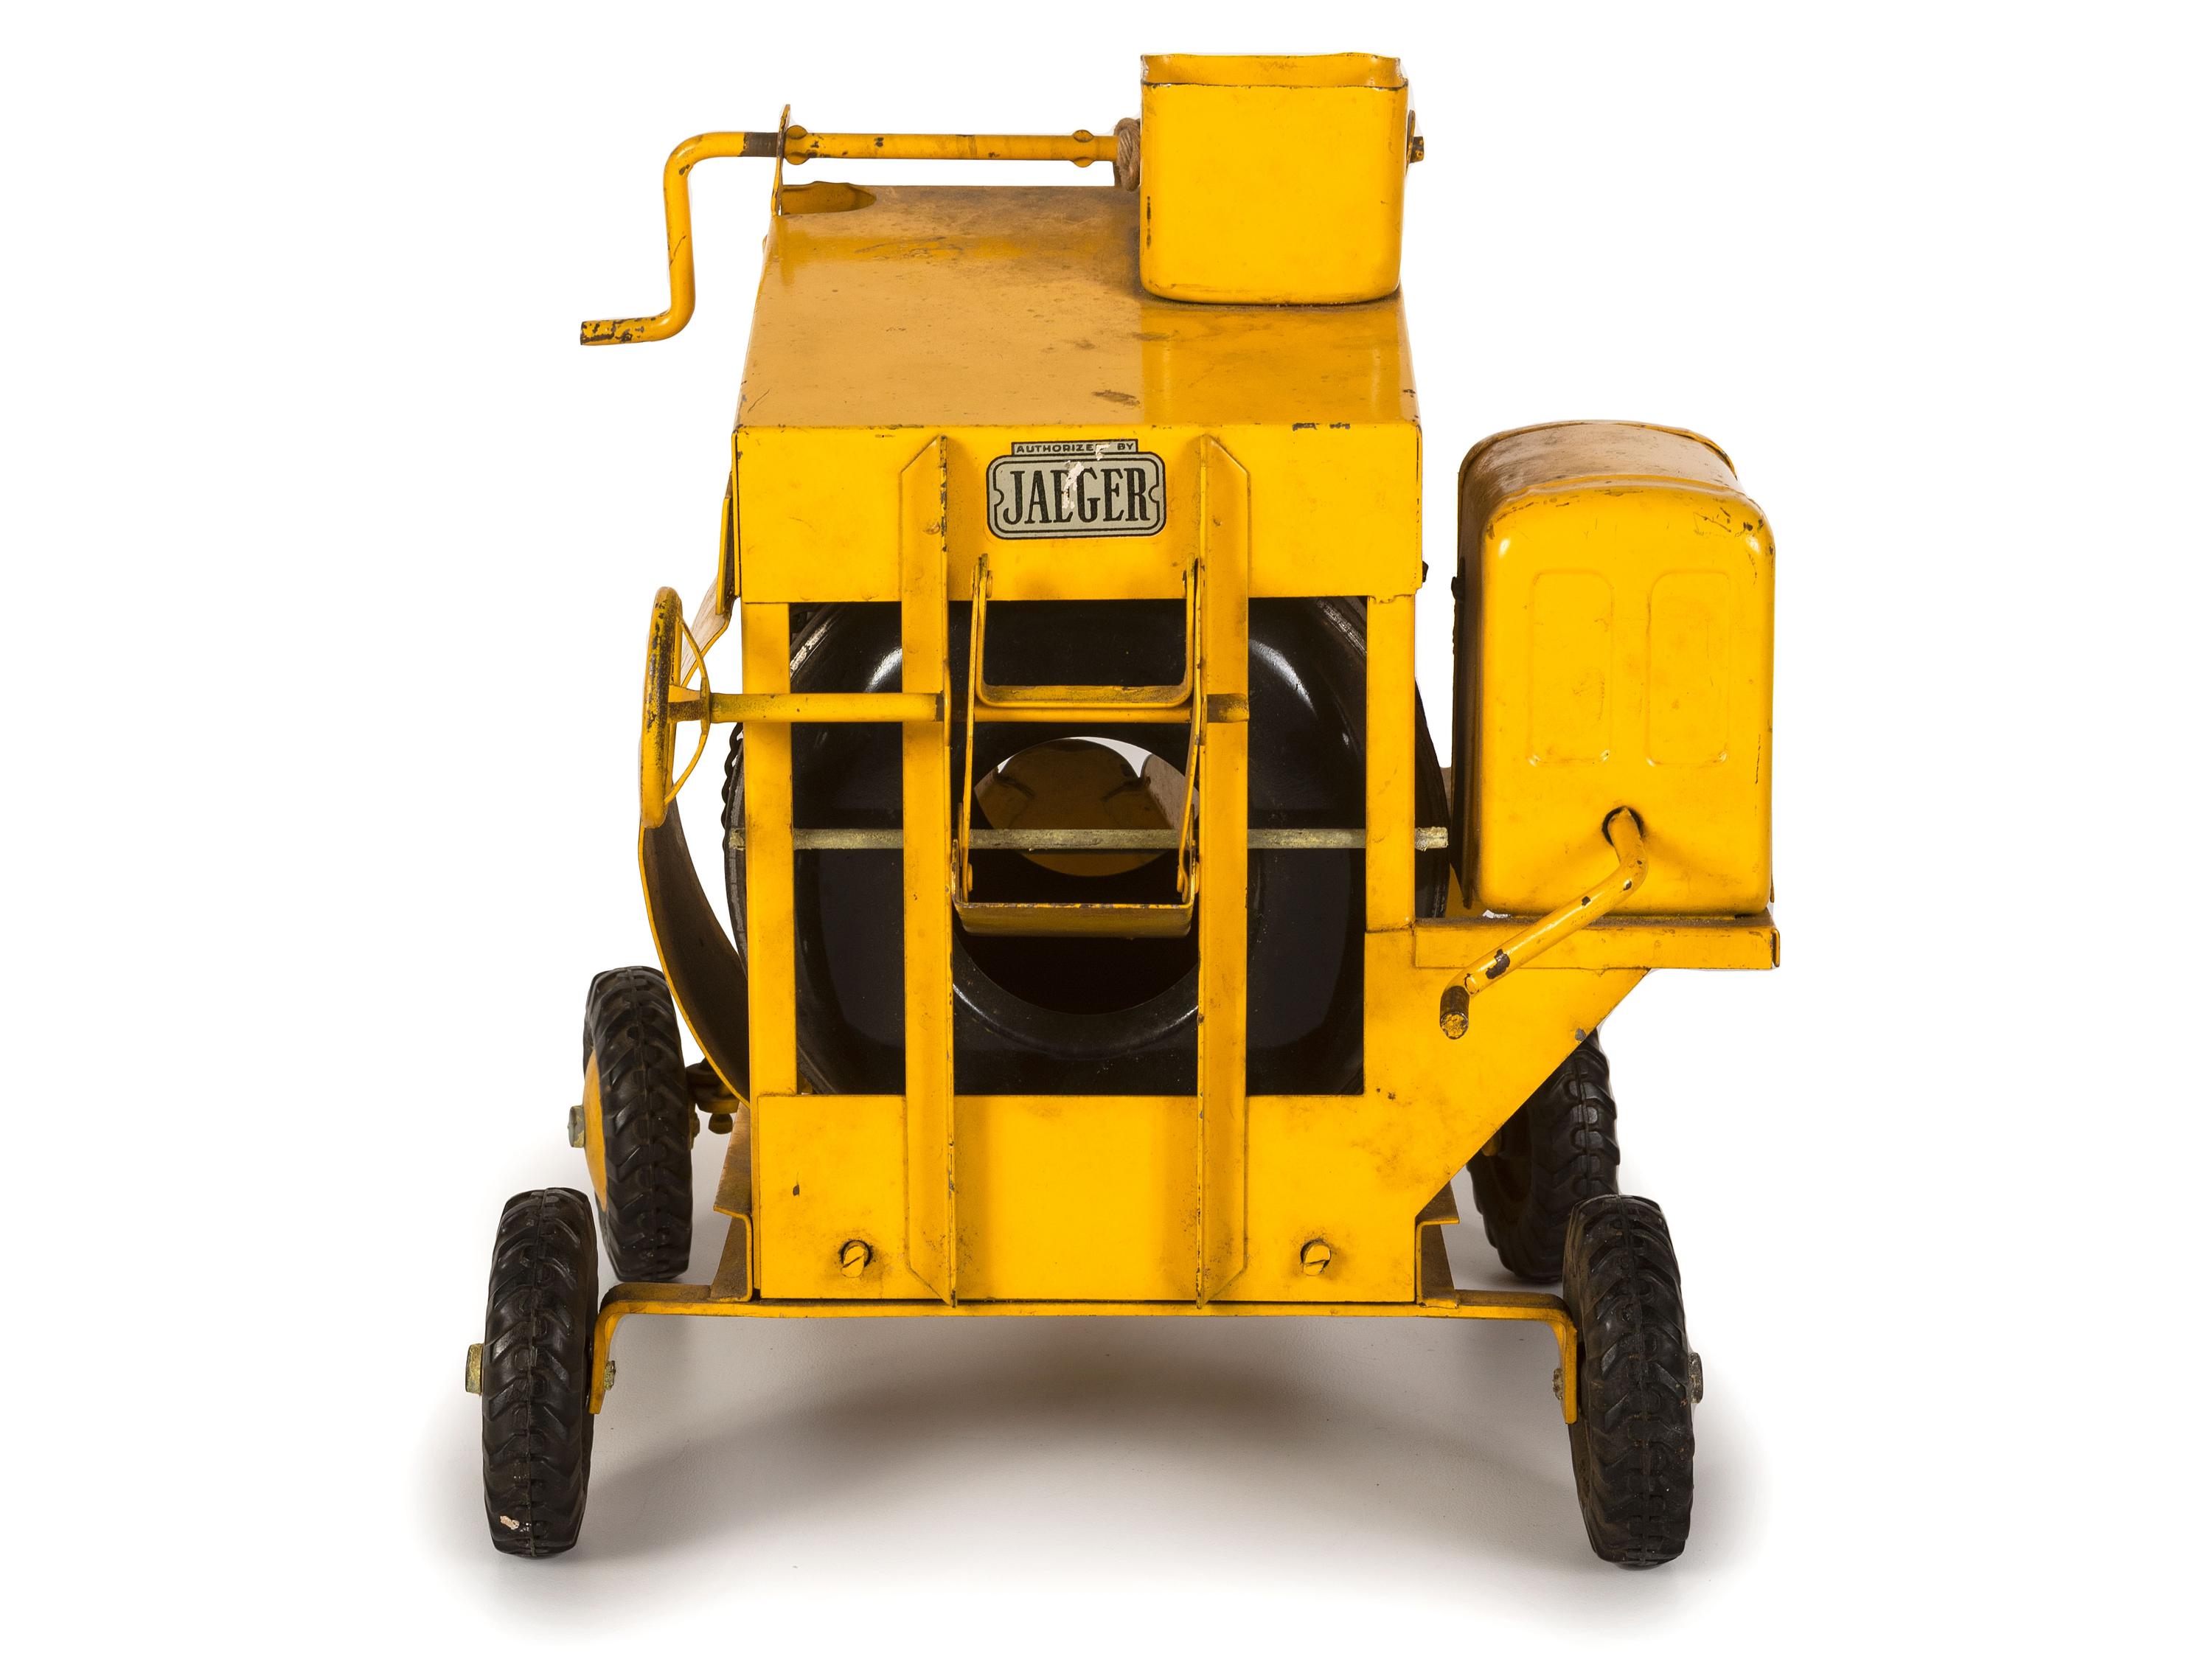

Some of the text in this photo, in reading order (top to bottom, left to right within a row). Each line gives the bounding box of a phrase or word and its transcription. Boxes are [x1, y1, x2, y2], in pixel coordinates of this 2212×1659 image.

[1017, 442, 1133, 453] AUTHORIZE BY
[1003, 467, 1150, 524] JAEGER
